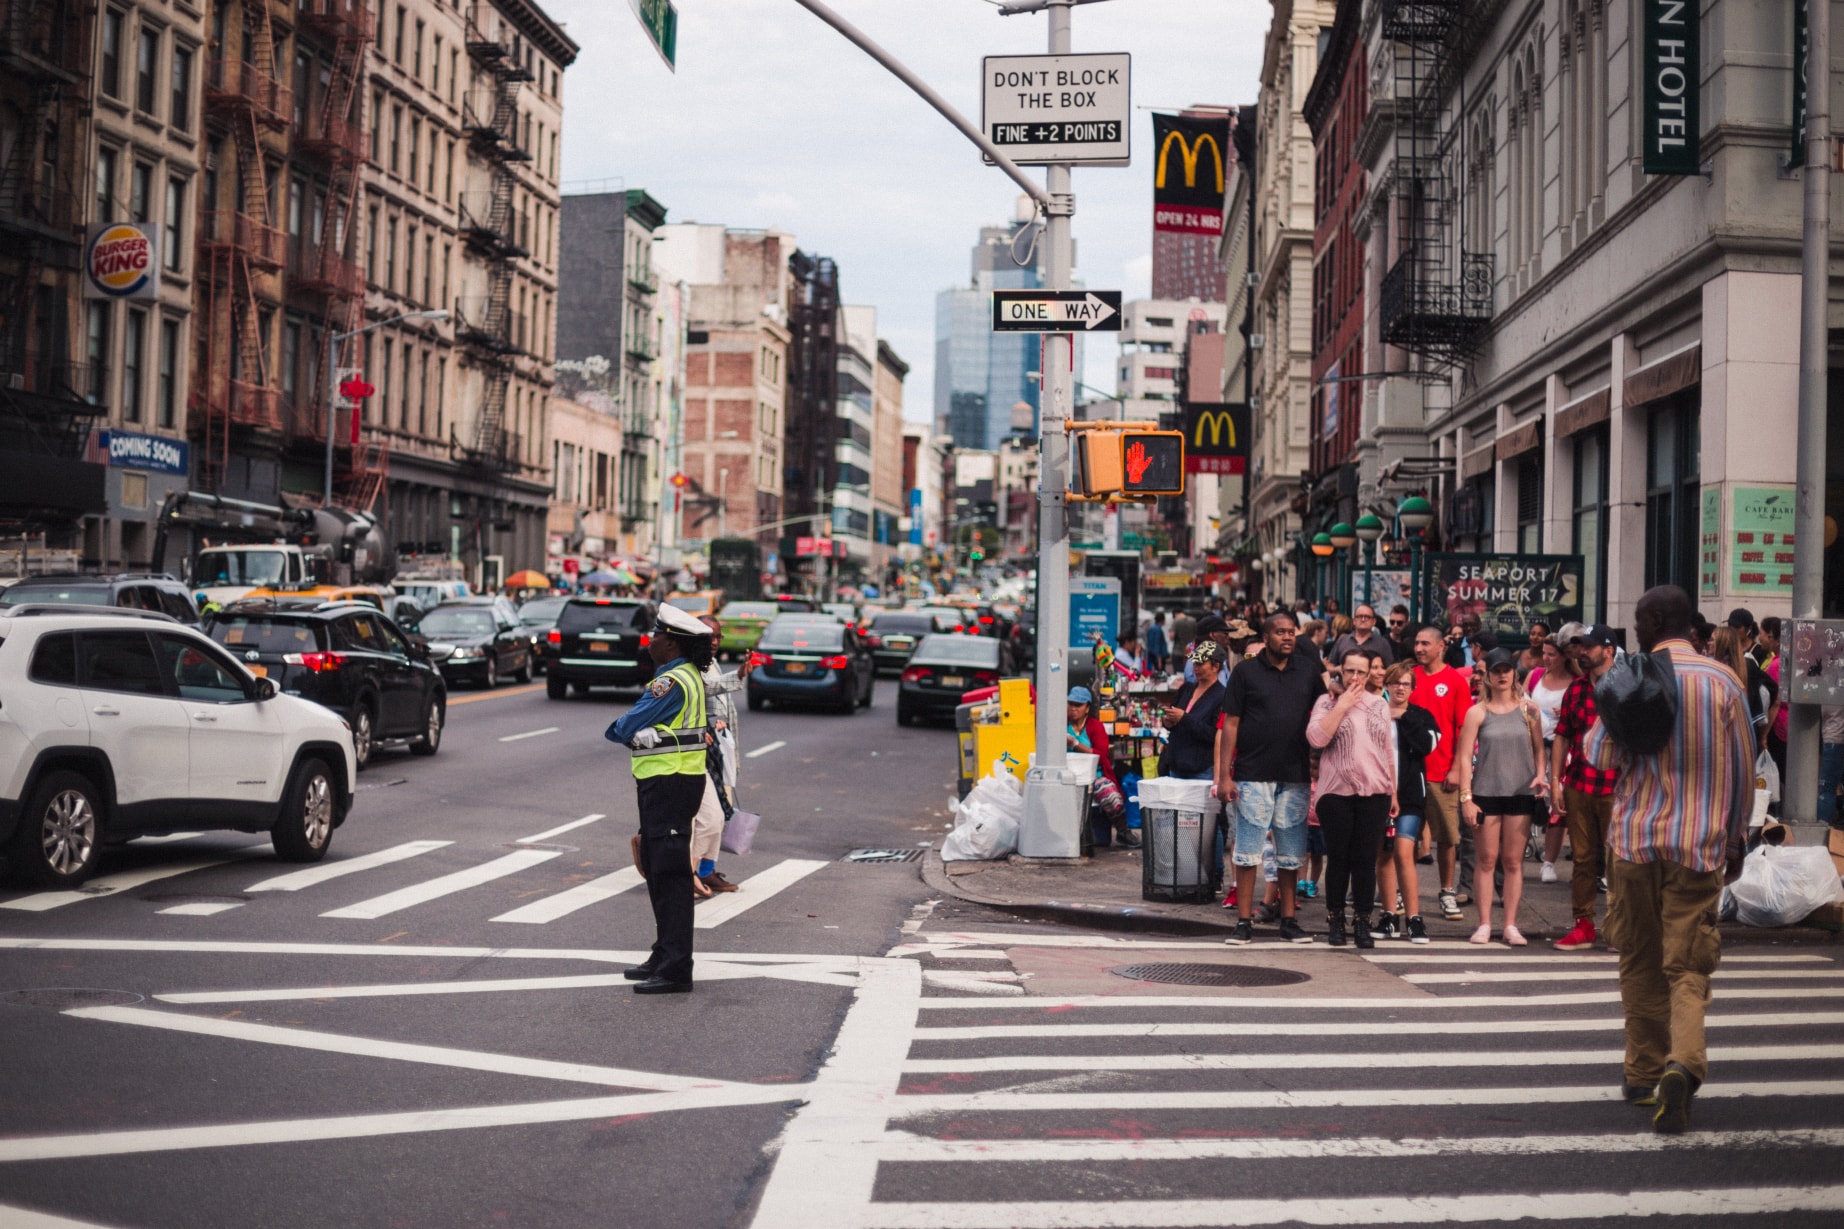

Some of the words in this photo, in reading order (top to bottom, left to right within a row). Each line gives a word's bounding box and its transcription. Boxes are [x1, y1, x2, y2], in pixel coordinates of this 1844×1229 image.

[995, 71, 1049, 87] DON'T
[1057, 69, 1119, 86] BLOCK
[1017, 93, 1053, 109] THE
[1061, 92, 1096, 108] BOX
[1658, 39, 1686, 154] HOTEL
[997, 126, 1029, 142] FINE
[1064, 123, 1117, 141] POINTS
[1156, 211, 1183, 225] OPEN
[1185, 213, 1199, 227] 24
[1201, 215, 1221, 229] HRS
[94, 238, 148, 260] BURGER
[93, 250, 148, 278] KING
[1011, 303, 1048, 319] ONE
[1065, 303, 1102, 319] WAY
[110, 437, 151, 458] COMING
[152, 440, 180, 468] SOON
[1459, 565, 1549, 582] SEAPORT
[1448, 586, 1531, 602] SUMMER
[1540, 588, 1558, 602] 17
